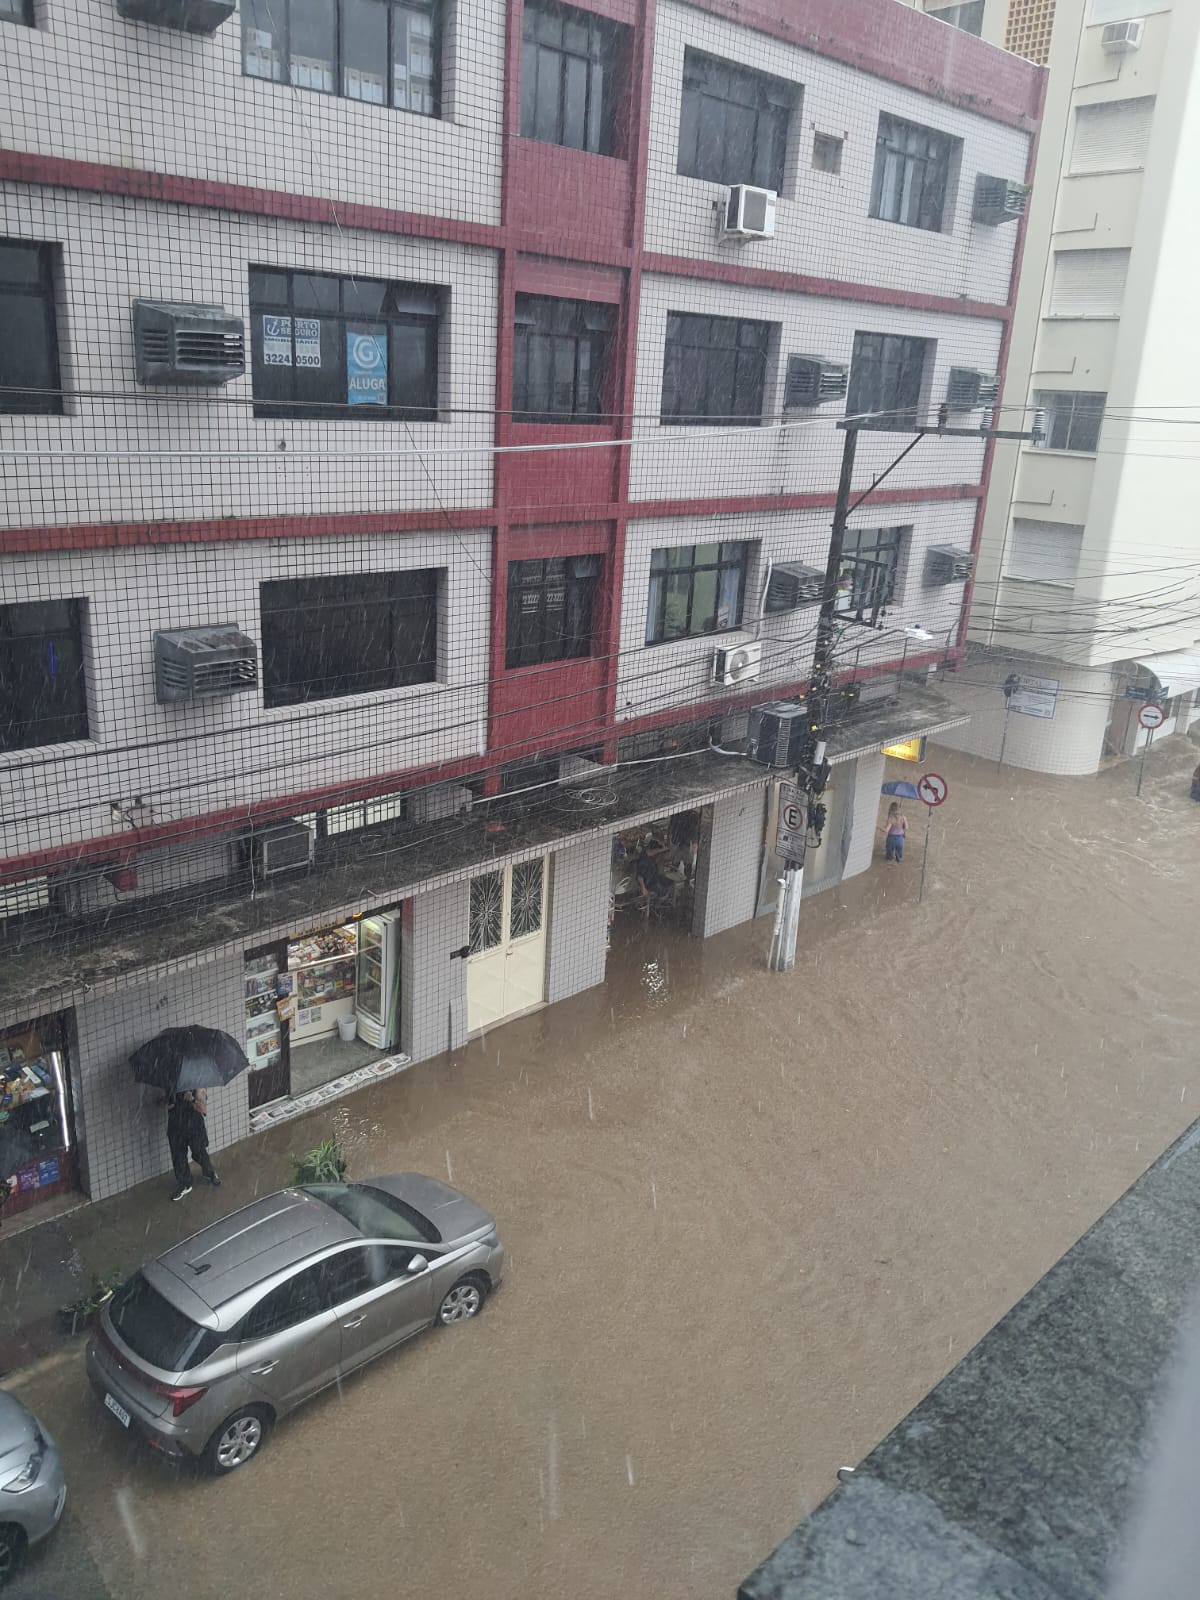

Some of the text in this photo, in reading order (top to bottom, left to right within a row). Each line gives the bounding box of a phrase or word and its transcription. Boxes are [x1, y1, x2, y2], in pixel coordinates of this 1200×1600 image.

[280, 319, 318, 330] PORTO
[280, 327, 318, 337] SEGURO
[349, 377, 386, 390] ALUGA
[788, 808, 798, 826] E
